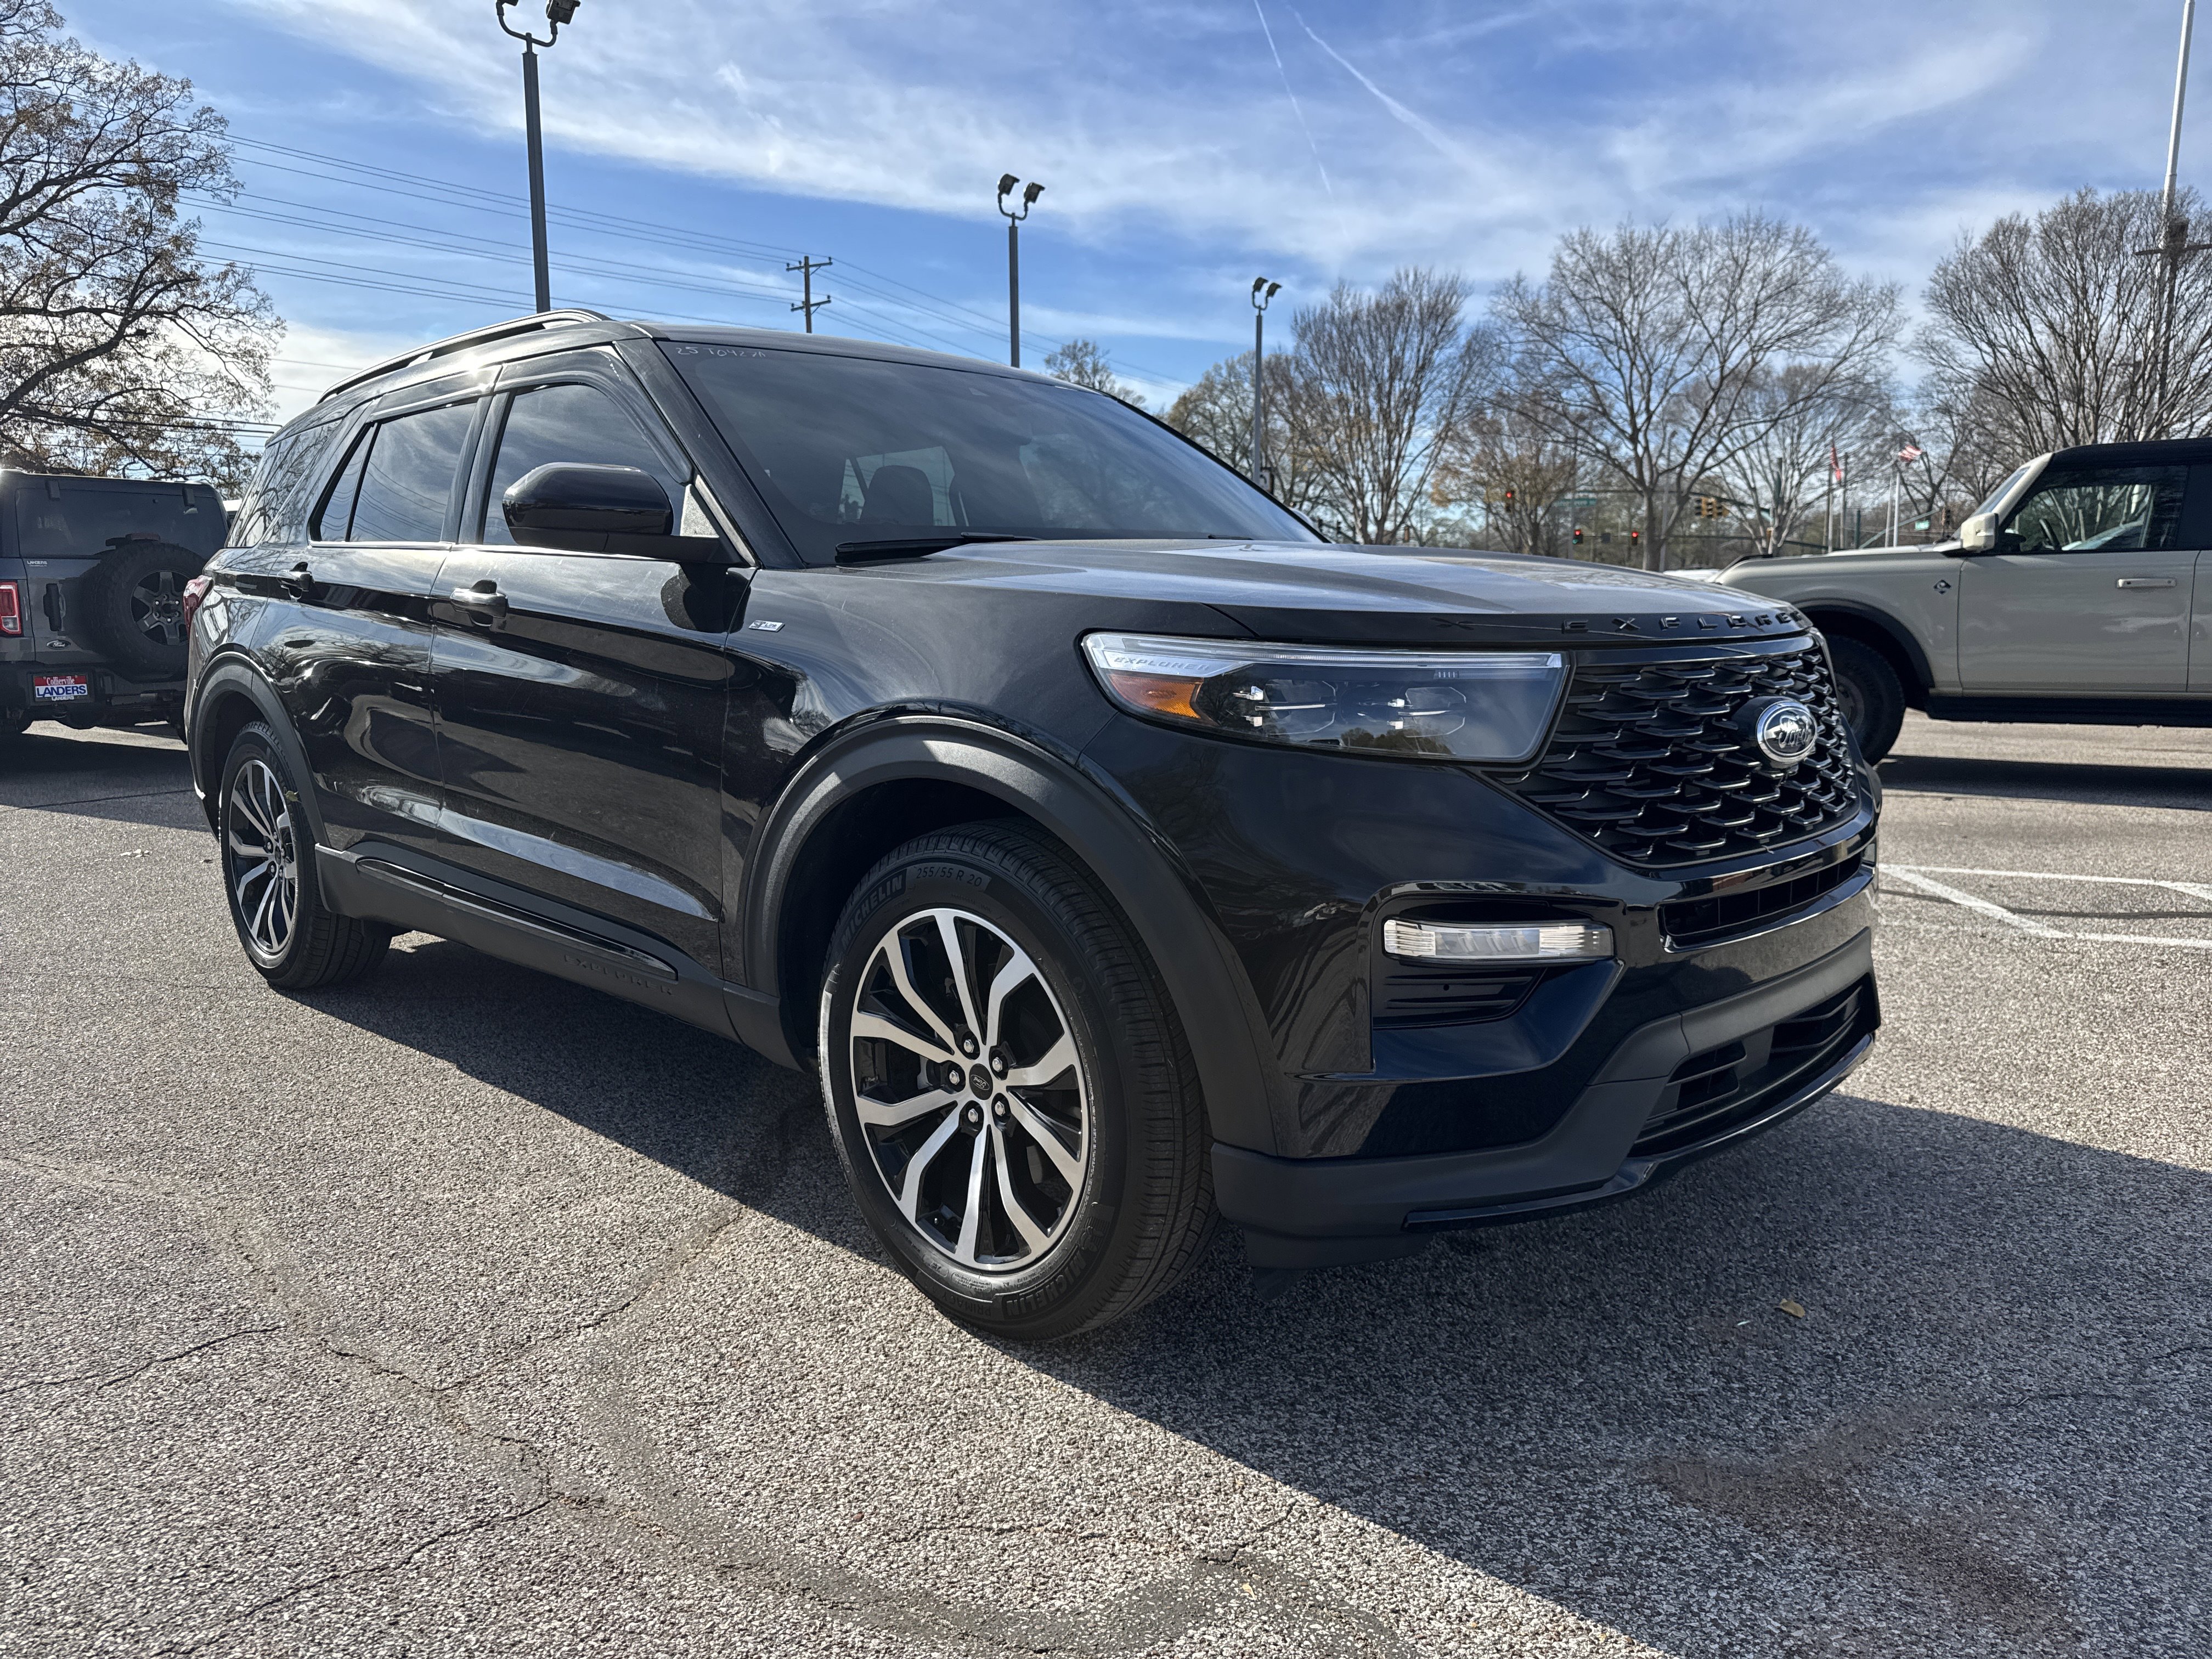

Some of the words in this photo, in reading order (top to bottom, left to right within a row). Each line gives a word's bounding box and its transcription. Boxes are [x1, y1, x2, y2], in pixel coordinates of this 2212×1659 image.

[1114, 657, 1210, 670] EXPLORER
[36, 685, 87, 697] LANDERS
[46, 675, 75, 686] Collierville
[916, 866, 954, 878] 255/55
[956, 870, 965, 881] R
[967, 874, 983, 887] 20
[840, 874, 903, 950] MICHELIN
[1006, 1250, 1087, 1317] MICHELIN
[942, 1291, 991, 1317] PRIMACY
